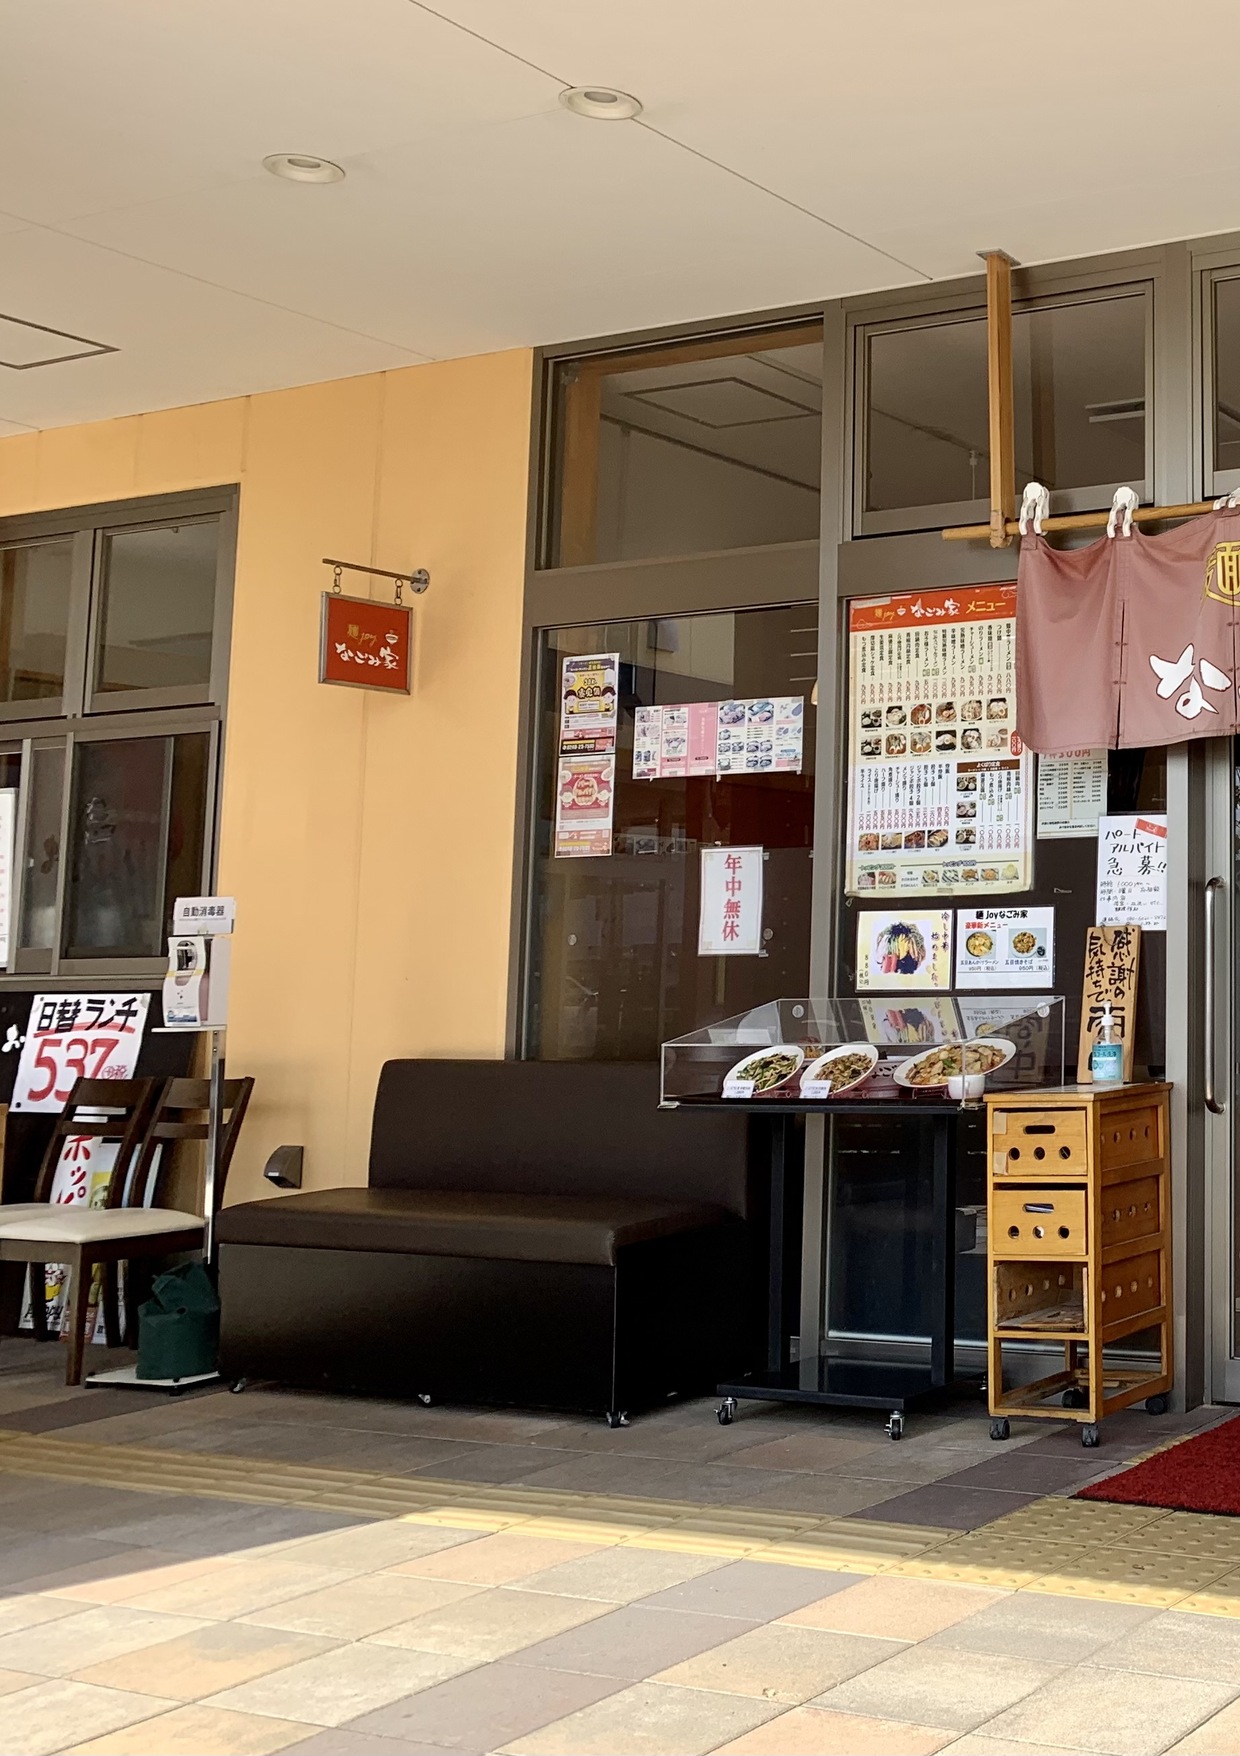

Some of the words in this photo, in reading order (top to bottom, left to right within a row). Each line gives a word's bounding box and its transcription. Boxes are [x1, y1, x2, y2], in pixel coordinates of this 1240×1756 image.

[966, 600, 1006, 613] メニュー
[335, 642, 399, 669] なごみ家
[1105, 828, 1141, 840] パート
[1110, 841, 1166, 853] アルバイト
[721, 853, 743, 941] 年中無休
[183, 905, 225, 918] 自動消毒器
[1106, 927, 1136, 1001] 感謝の
[37, 997, 139, 1034] 日替ランチ
[27, 1038, 120, 1102] 537
